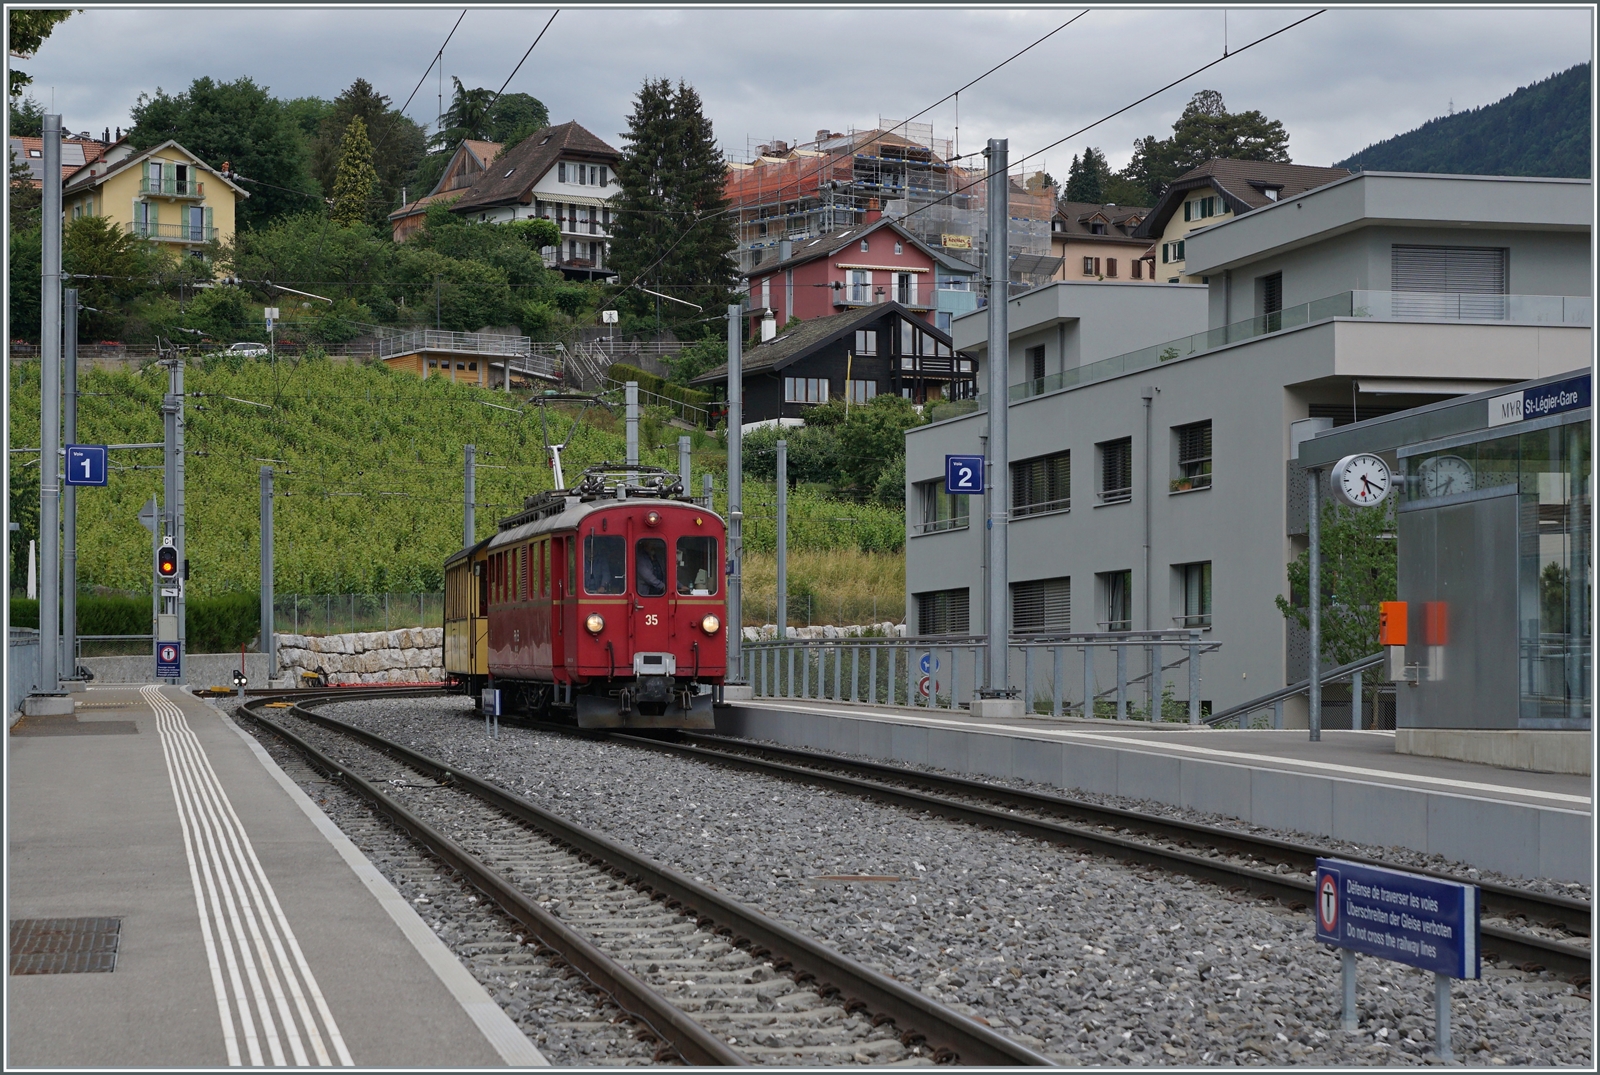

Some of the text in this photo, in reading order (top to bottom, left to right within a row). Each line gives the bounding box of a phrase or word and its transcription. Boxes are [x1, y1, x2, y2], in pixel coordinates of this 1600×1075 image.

[1525, 391, 1578, 414] St-Légier-Gare
[80, 458, 90, 478] 1
[958, 467, 972, 487] 2
[645, 614, 659, 626] 35
[1346, 879, 1439, 912] Défense de traverser les voies
[1346, 897, 1453, 938] Überschreiten der Gleise verboten
[1346, 922, 1437, 958] Do not cross the railway lines
